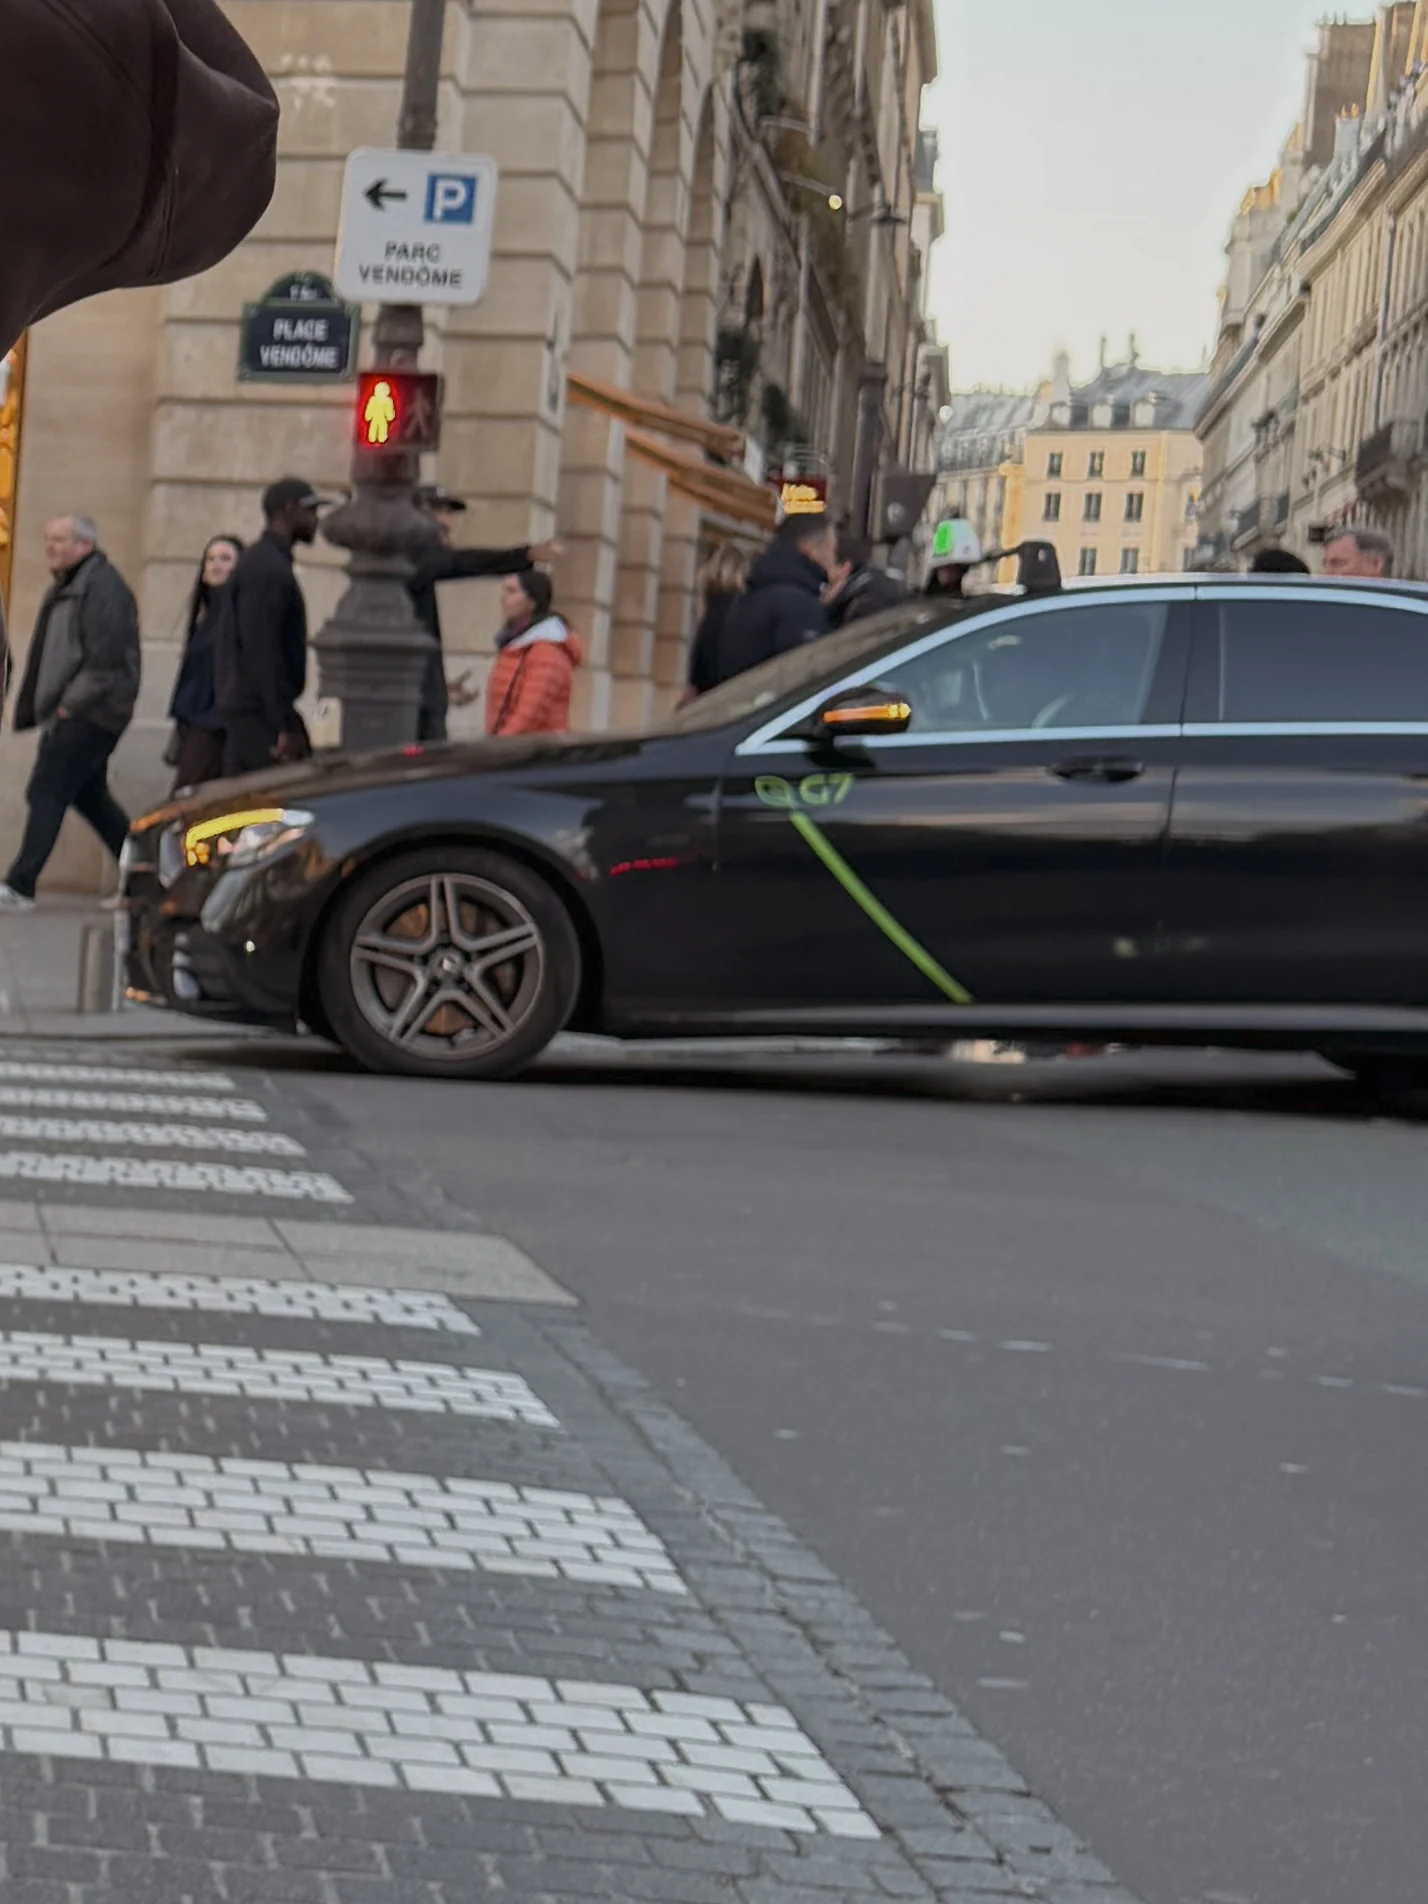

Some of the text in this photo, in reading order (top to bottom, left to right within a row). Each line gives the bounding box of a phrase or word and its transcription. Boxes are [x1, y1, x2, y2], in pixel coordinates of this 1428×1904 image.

[384, 241, 441, 264] PARC
[272, 317, 329, 342] PLACE
[258, 341, 341, 368] VENDÔME
[799, 772, 854, 806] G7
